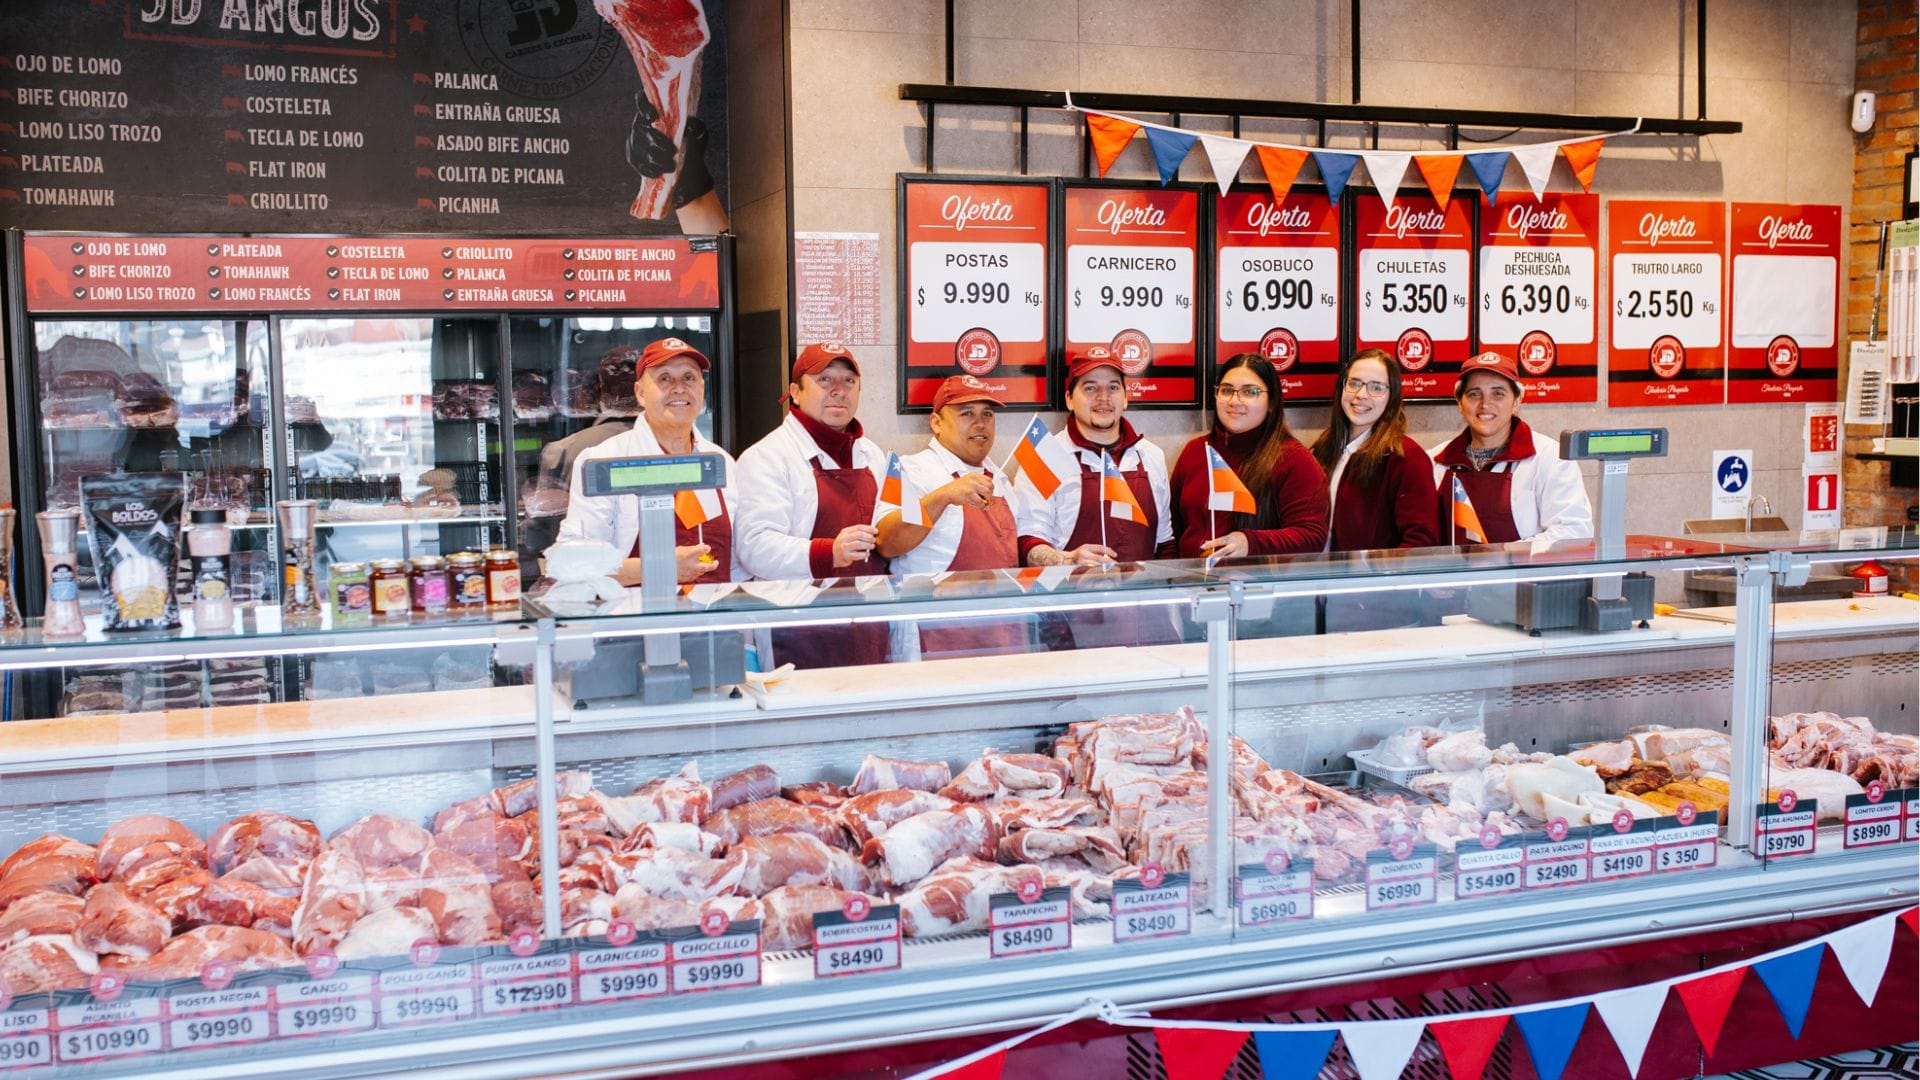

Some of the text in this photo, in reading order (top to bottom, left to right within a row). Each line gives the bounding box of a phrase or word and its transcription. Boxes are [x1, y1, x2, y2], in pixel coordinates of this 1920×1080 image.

[219, 0, 380, 41] ANGUS
[16, 55, 122, 75] OJO DE LOMO
[245, 64, 358, 85] LOMO FRANCÉS
[435, 72, 498, 90] PALANCA
[17, 88, 128, 109] BIFE CHORIZO
[246, 97, 331, 115] COSTELETA
[435, 103, 561, 124] ENTRAÑA GRUESA
[19, 121, 161, 142] LOMO LISO TROZO
[248, 129, 364, 148] TECLA DE LOMO
[437, 135, 570, 154] ASADO BIFE ANCHO
[21, 155, 104, 174] PLATEADA
[249, 161, 326, 179] FLAT IRON
[437, 166, 564, 185] COLITA DE PICANA
[23, 187, 115, 206] TOMAHAWK
[251, 192, 328, 210] CRIOLLITO
[439, 197, 500, 214] PICANHA
[942, 195, 1013, 231] Oferta
[1098, 200, 1165, 235] Oferta
[1248, 202, 1311, 237] Oferta
[1386, 205, 1445, 239] Oferta
[1507, 204, 1568, 239] Oferta
[1639, 213, 1696, 247] Oferta
[1758, 216, 1813, 249] Oferta
[88, 243, 166, 256] OJO DE LOMO
[223, 244, 282, 258] PLATEADA
[342, 246, 405, 259] COSTELETA
[456, 247, 512, 260] CRIOLLITO
[577, 248, 675, 261] ASADO BIFE ANCHO
[1514, 252, 1561, 263] PECHUGA
[945, 254, 1008, 268] POSTAS
[1087, 256, 1176, 271] CARNICERO
[1242, 259, 1314, 272] OSOBUCO
[1377, 261, 1446, 273] CHULETAS
[1504, 264, 1571, 276] DESHUESADA
[1632, 263, 1703, 274] TRUTRO LARGO
[89, 265, 171, 278] BIFE CHORIZO
[224, 266, 289, 279] TOMAHAWK
[342, 267, 429, 280] TECLA DE LOMO
[457, 268, 506, 281] PALANCA
[578, 269, 671, 281] COLITA DE PICANA
[90, 287, 195, 300] LOMO LISO TROZO
[225, 285, 310, 301] LOMO FRANCÉS
[343, 288, 401, 301] FLAT IRON
[458, 287, 553, 302] ENTRAÑA GRUESA
[579, 289, 626, 302] PICANHA
[918, 282, 1043, 307] $ 9.990 Kg.
[1074, 286, 1192, 309] $ 9.990 Kg.
[1226, 279, 1336, 312] $ 6.990 Kg.
[1365, 283, 1468, 314] $ 5.350 Kg.
[1484, 293, 1490, 311] $
[1575, 295, 1589, 309] Kg.
[1617, 300, 1622, 317] $
[112, 509, 158, 523] BOLDOS
[126, 503, 144, 511] LOS
[1782, 814, 1812, 823] AHUMADA
[1853, 824, 1890, 841] $8990
[1529, 843, 1585, 856] PATA VACUNO
[1768, 834, 1804, 851] $9790
[1604, 855, 1643, 873] $4190
[1662, 848, 1699, 866] $ 350
[1465, 872, 1515, 891] $5490
[1536, 864, 1577, 882] $2490
[1123, 891, 1179, 905] PLATEADA
[1378, 883, 1421, 902] $6990
[1003, 904, 1058, 918] TAPAPECHO
[1250, 901, 1297, 921] $6990
[822, 923, 893, 938] SOBRECOSTILLA
[1128, 914, 1176, 934] $8490
[681, 938, 750, 954] CHOCLILLO
[1002, 927, 1053, 948] $8490
[585, 948, 659, 965] CARNICERO
[830, 948, 883, 969] $8490
[426, 968, 466, 979] GANSO
[486, 959, 567, 974] PUNTA GANSO
[688, 963, 744, 984] $9990
[300, 982, 348, 996] GANSO
[601, 973, 658, 994] $9990
[176, 991, 261, 1008] POSTA NEGRA
[496, 983, 566, 1004] $12990
[397, 996, 458, 1018] $9990
[4, 1015, 37, 1027] LISO
[294, 1006, 356, 1029] $9990
[187, 1017, 252, 1041] $9990
[68, 1028, 149, 1055] $10990
